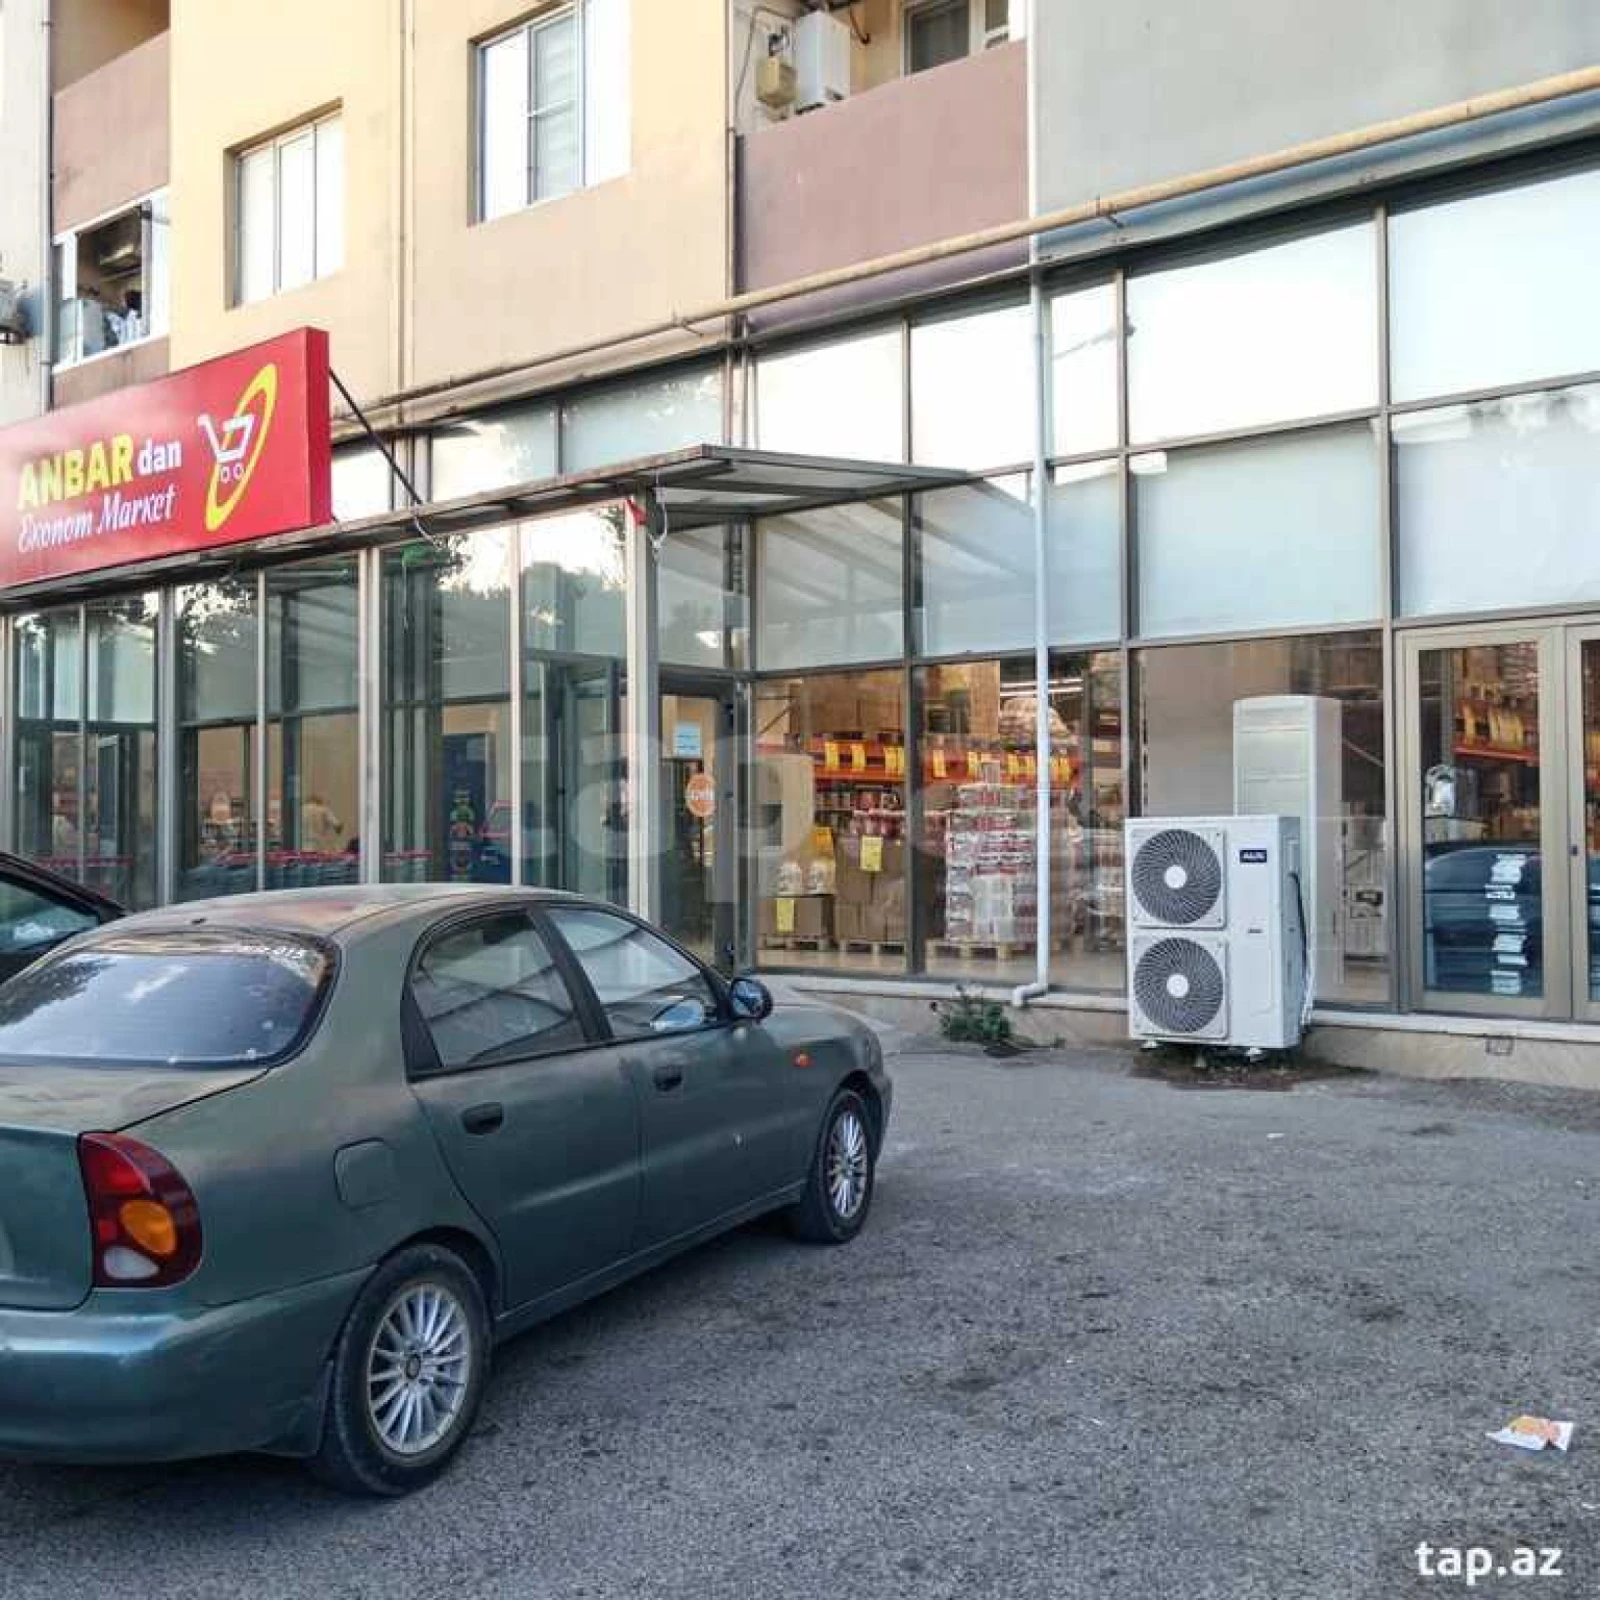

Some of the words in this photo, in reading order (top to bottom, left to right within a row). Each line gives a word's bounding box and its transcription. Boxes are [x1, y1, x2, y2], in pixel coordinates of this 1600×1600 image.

[17, 434, 133, 511] ANBAR
[138, 439, 182, 475] dan
[18, 513, 93, 553] Ekonom
[97, 483, 176, 533] Market
